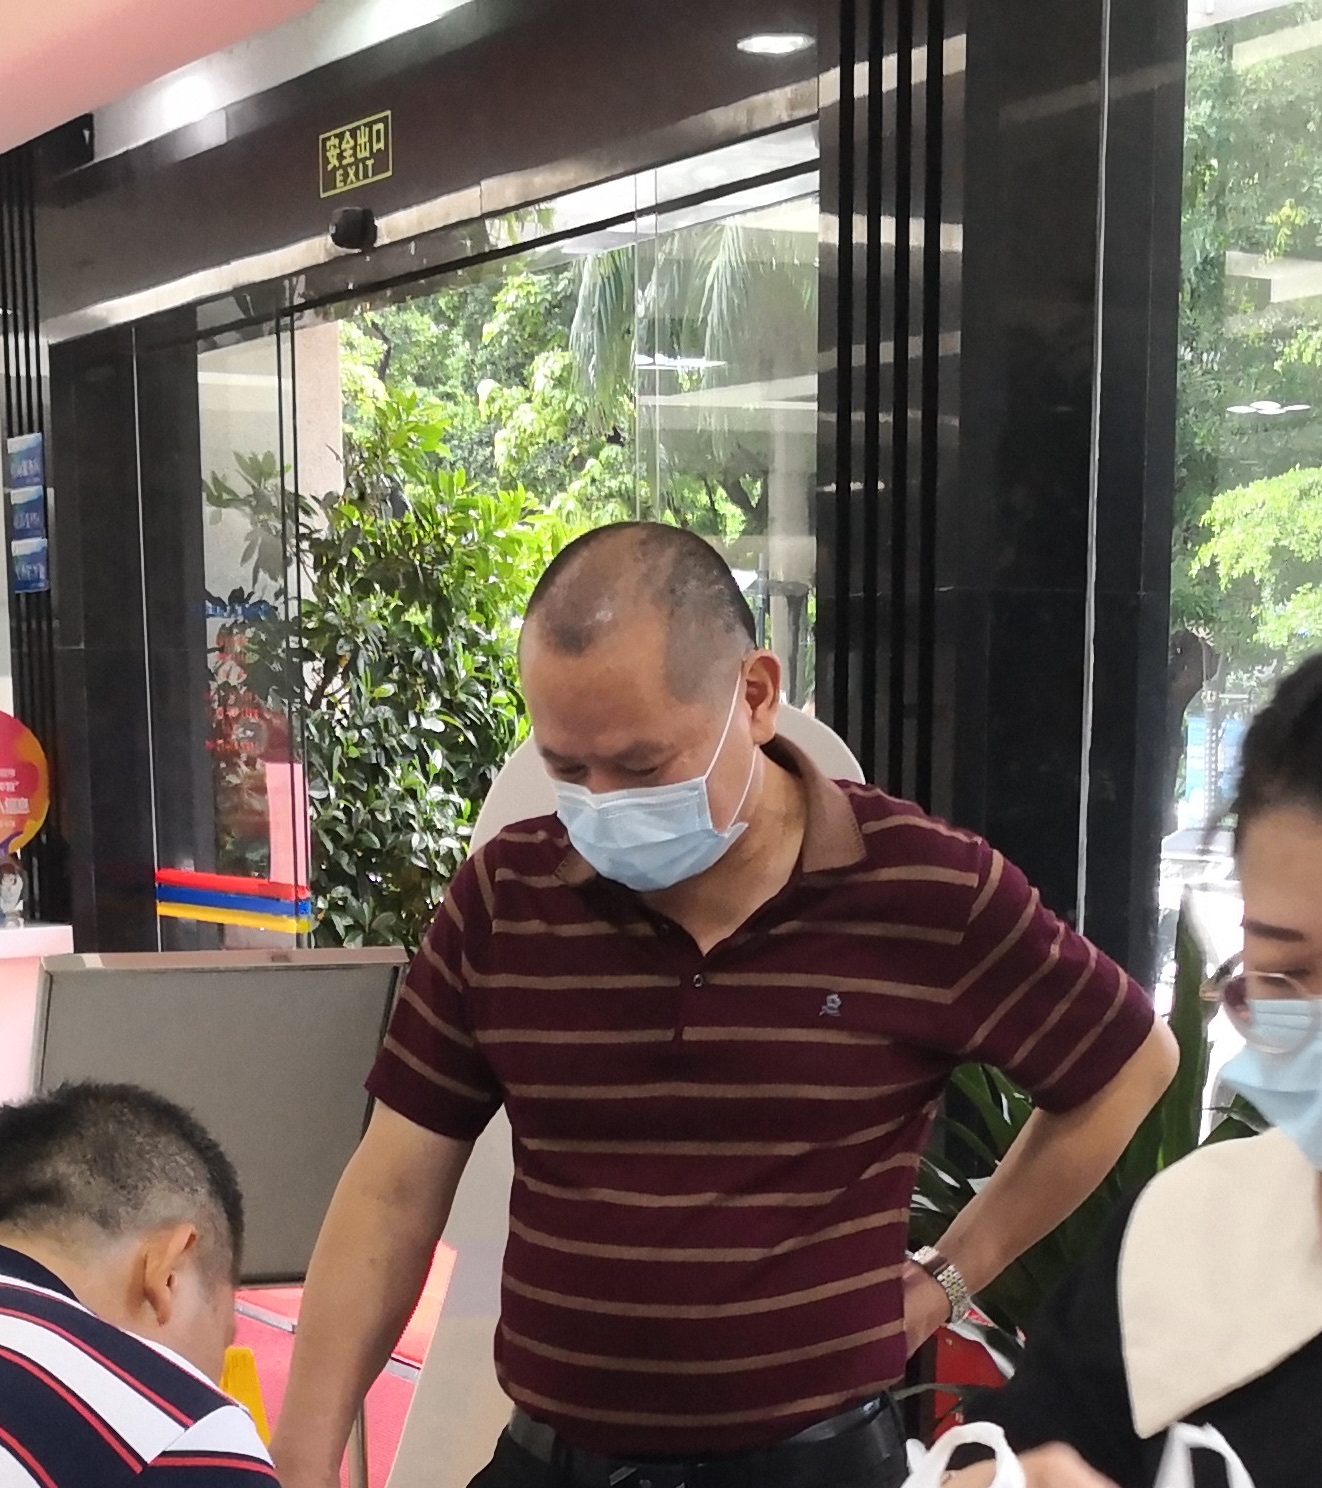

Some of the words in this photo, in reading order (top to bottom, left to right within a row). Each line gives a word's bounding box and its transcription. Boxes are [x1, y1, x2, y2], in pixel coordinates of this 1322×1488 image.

[325, 123, 385, 171] 安全出口
[336, 158, 375, 188] EXIT
